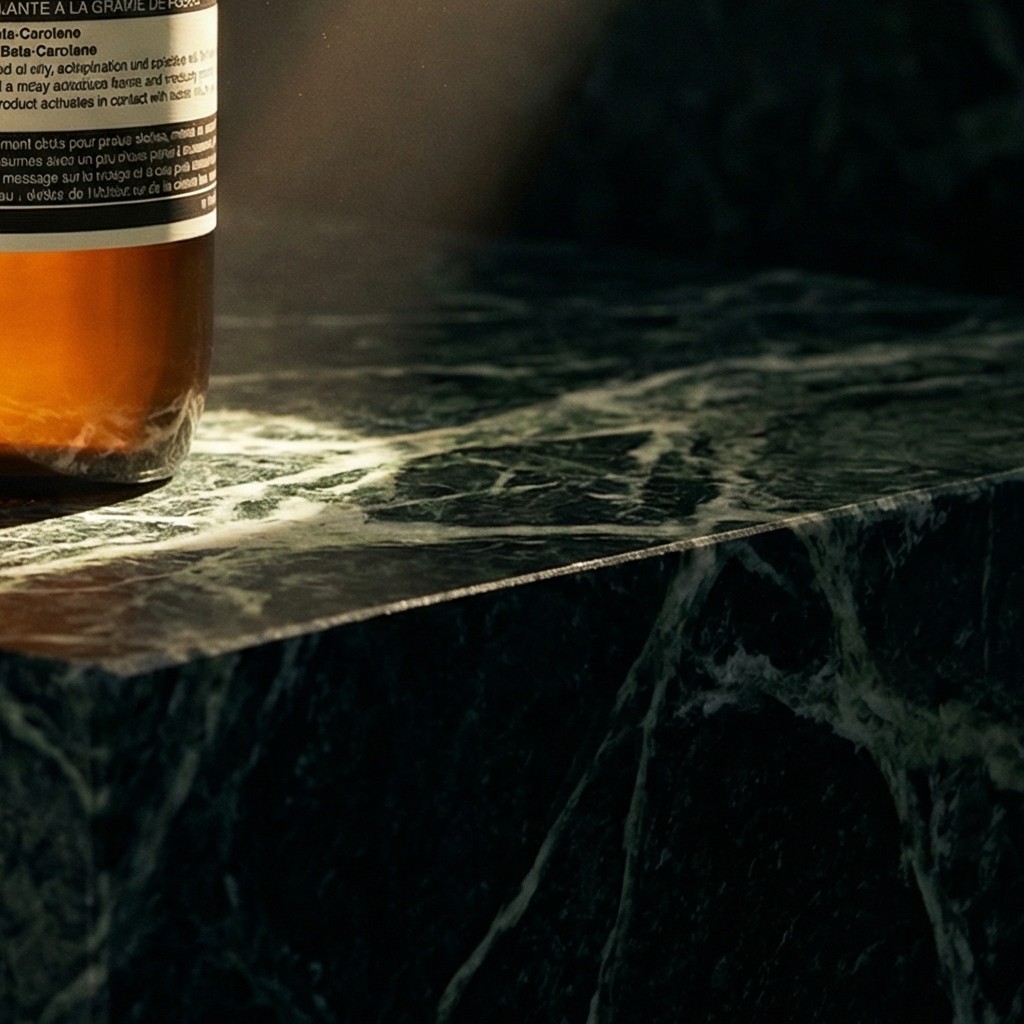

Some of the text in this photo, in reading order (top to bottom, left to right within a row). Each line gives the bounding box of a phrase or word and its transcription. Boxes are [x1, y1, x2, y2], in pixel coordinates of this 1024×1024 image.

[54, 0, 66, 15] A
[69, 0, 89, 15] LA
[69, 137, 96, 152] pour
[77, 156, 93, 165] un
[2, 174, 59, 187] message
